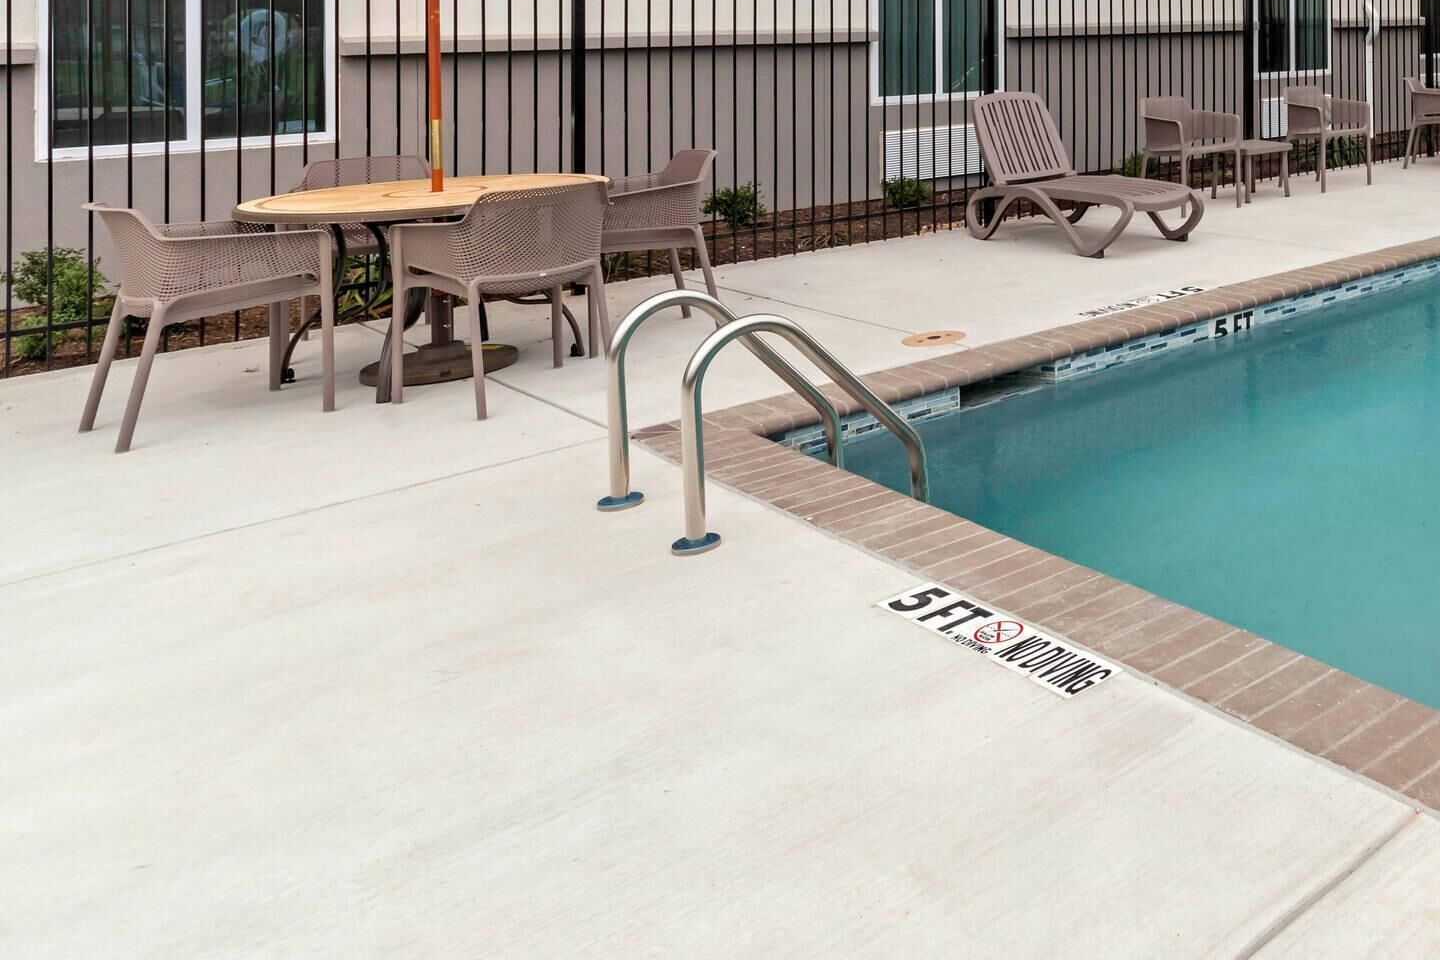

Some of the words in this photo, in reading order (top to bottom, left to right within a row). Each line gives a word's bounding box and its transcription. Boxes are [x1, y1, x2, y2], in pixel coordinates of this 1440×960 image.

[1214, 317, 1228, 339] 5
[1233, 310, 1254, 333] FT
[887, 587, 951, 612] 5
[993, 635, 1052, 663] NO
[1017, 646, 1112, 695] DIVING
